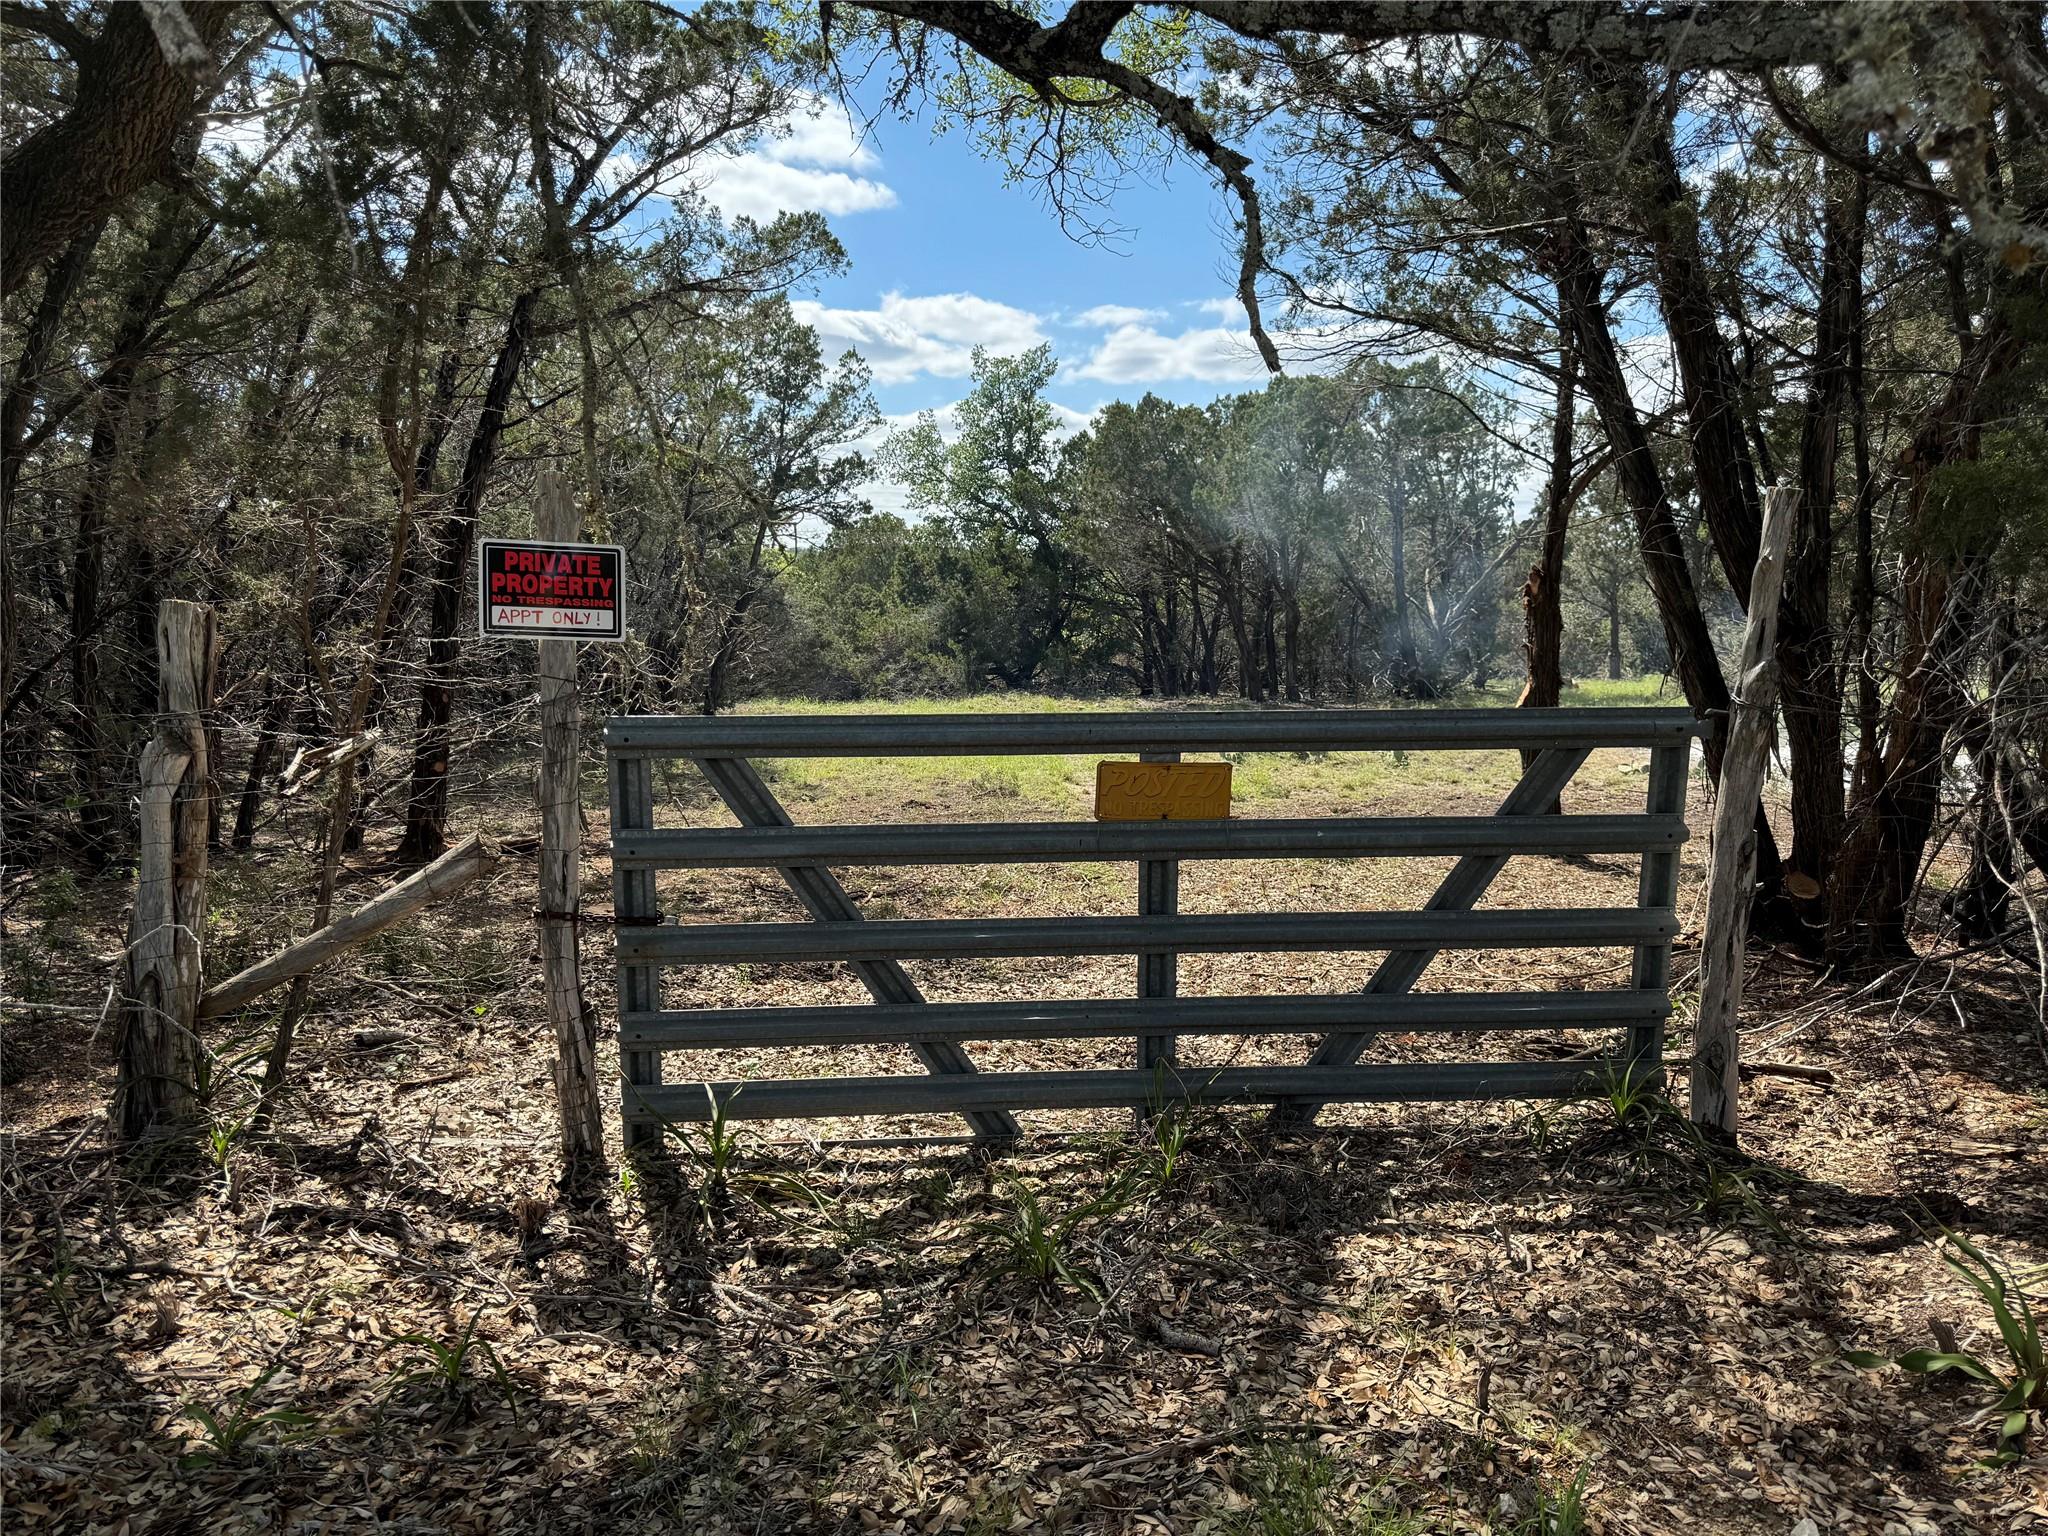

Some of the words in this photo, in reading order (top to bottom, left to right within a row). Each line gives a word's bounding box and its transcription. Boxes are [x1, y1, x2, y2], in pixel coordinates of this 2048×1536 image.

[504, 551, 601, 575] PRIVATE
[491, 572, 614, 597] PROPERTY
[491, 594, 512, 603] NO
[517, 595, 614, 608] TRESPASSING
[497, 608, 543, 624] APPT
[1101, 769, 1227, 798] POSTED
[1128, 799, 1225, 817] TRESPASSING
